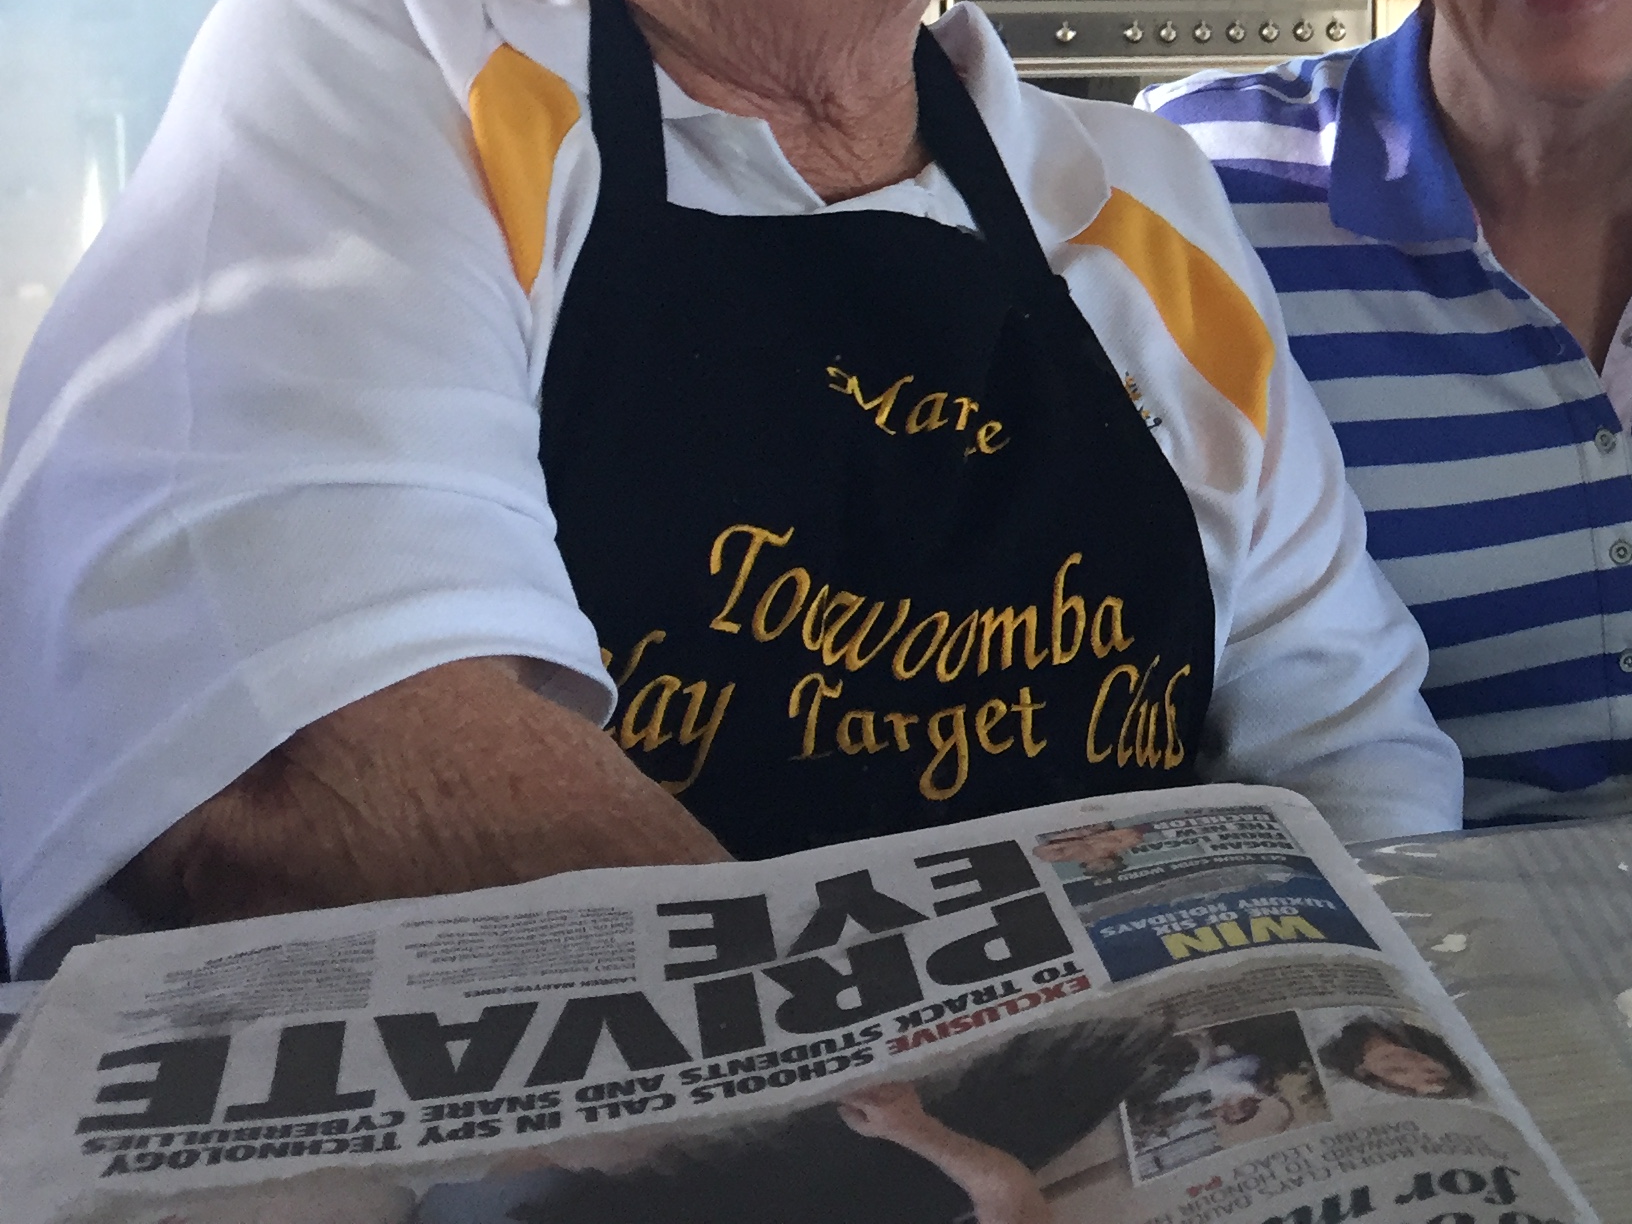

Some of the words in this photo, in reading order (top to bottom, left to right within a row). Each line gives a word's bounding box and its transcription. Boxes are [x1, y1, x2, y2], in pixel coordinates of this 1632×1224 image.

[788, 673, 1047, 801] Target
[1086, 655, 1190, 770] Club
[656, 840, 1041, 982] EYE
[1099, 902, 1228, 938] HOLIDAYS
[1151, 918, 1197, 936] SIX
[1159, 916, 1326, 960] WIN
[1031, 962, 1084, 987] TO
[75, 892, 1074, 1135] PRIVATE
[886, 975, 1092, 1057] EXCLUSIVE
[892, 979, 1022, 1035] TRACK
[678, 1025, 883, 1086] STUDENTS
[574, 1073, 665, 1104] AND
[688, 1050, 875, 1106] SCHOOLS
[420, 1090, 561, 1124] SNARE
[516, 1111, 562, 1135] IN
[575, 1092, 677, 1124] CALL
[81, 1110, 406, 1157] CYBERBULLIES
[415, 1119, 502, 1148] SPY
[99, 1133, 403, 1179] TECHNOLOGY
[1394, 1166, 1521, 1206] for
